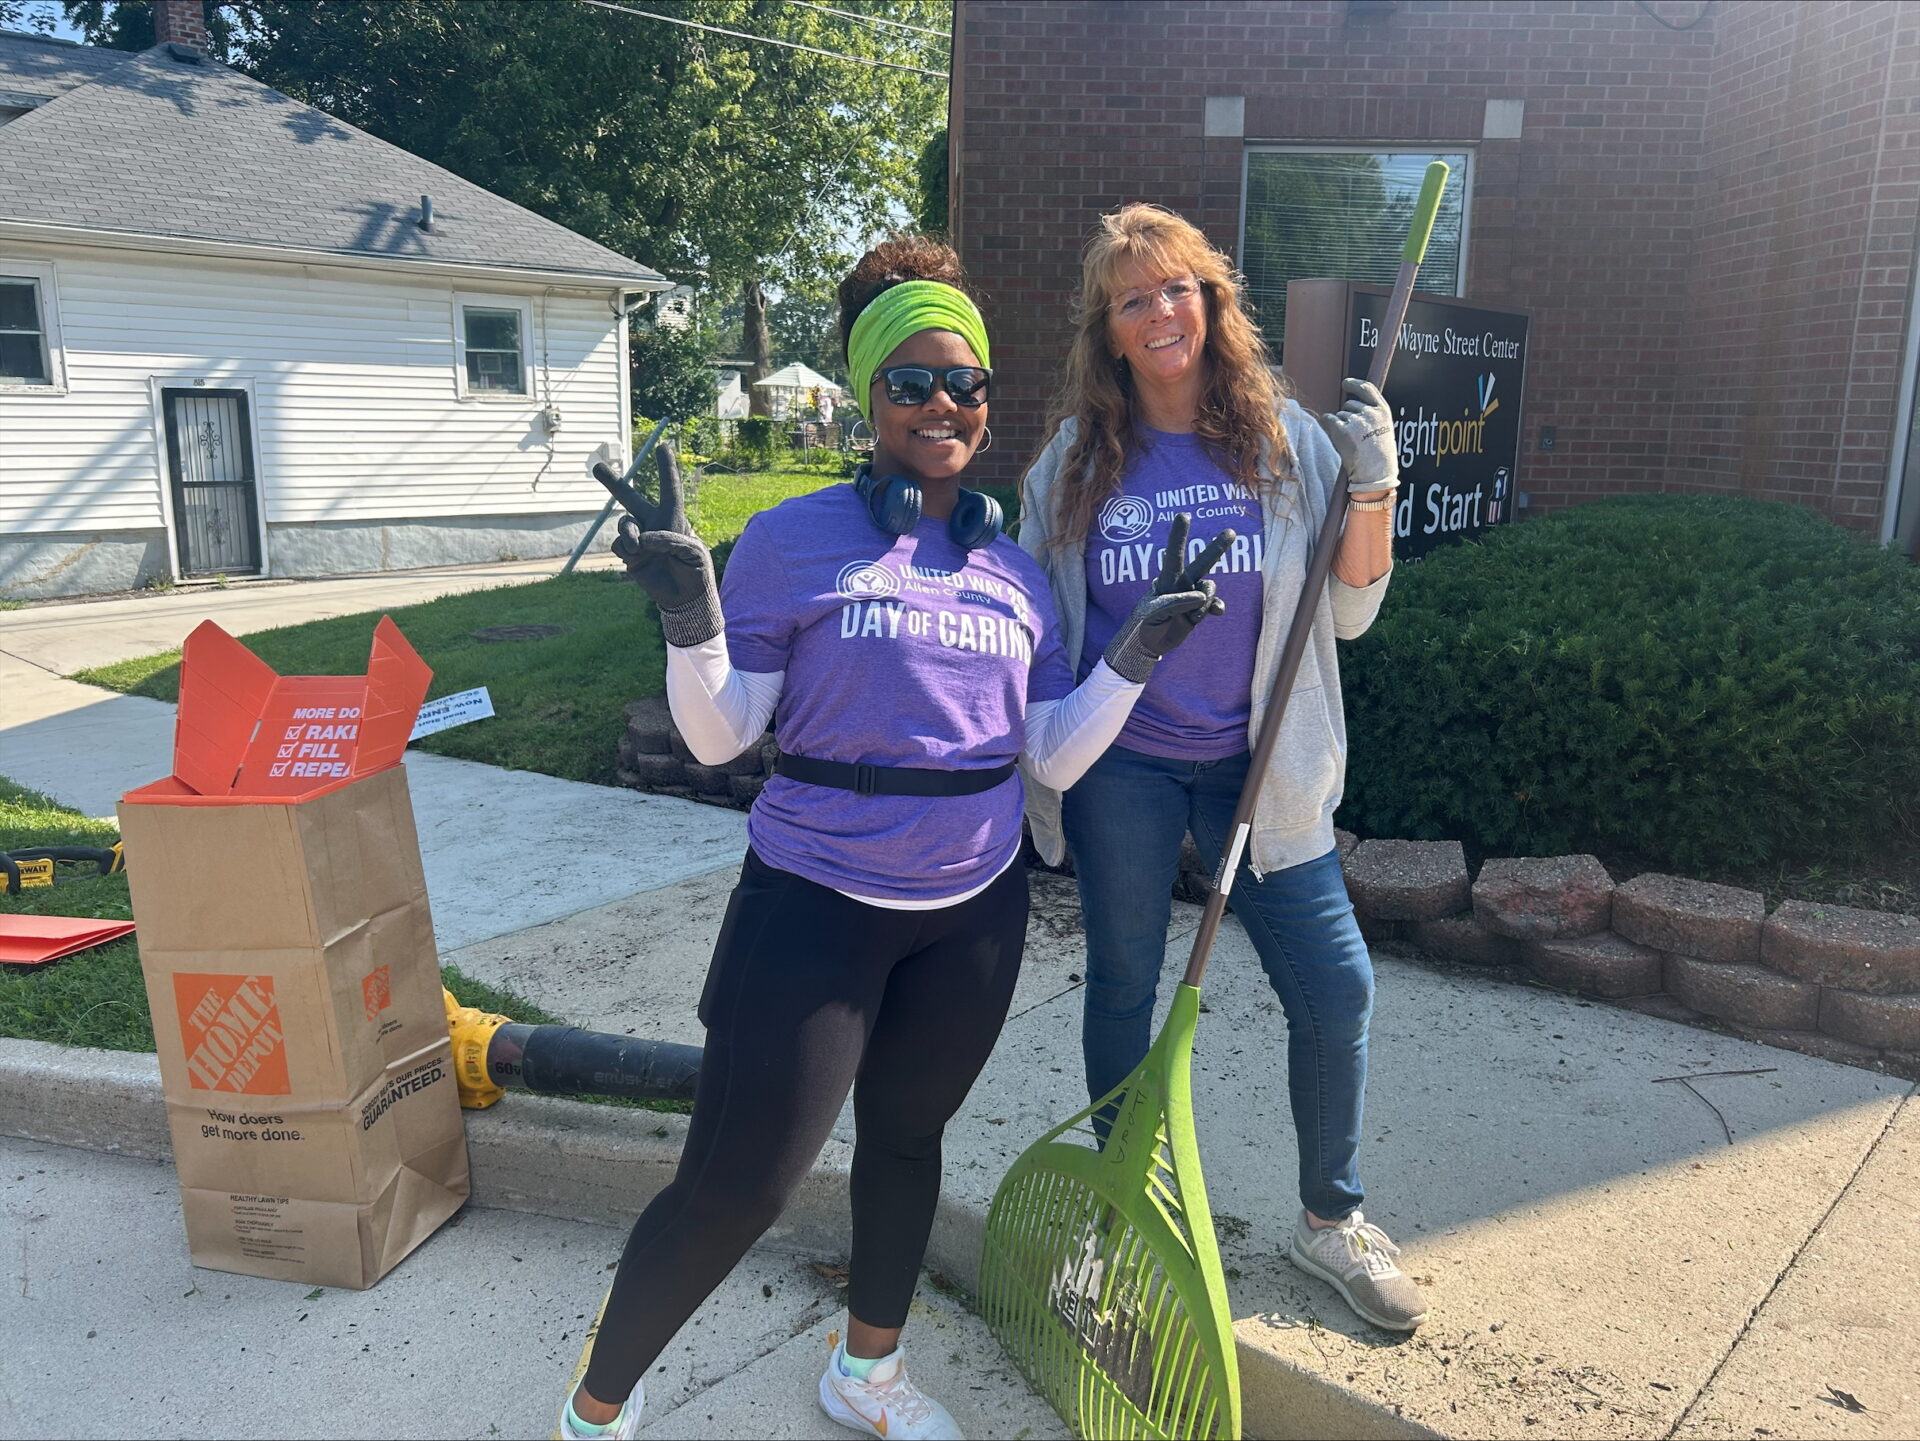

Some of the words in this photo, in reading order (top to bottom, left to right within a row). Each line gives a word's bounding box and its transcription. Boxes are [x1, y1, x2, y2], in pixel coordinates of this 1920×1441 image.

[1359, 318, 1379, 347] Ea
[1398, 323, 1440, 360] Wayne
[1444, 327, 1479, 356] Street
[1483, 332, 1519, 359] Center
[1155, 484, 1219, 509] UNITED
[1423, 483, 1482, 534] Start
[1196, 504, 1246, 519] County
[1100, 543, 1153, 585] DAY
[899, 563, 964, 589] UNITED
[966, 575, 1004, 598] WAY
[904, 580, 937, 596] Allen
[943, 588, 991, 604] County
[840, 601, 906, 639] DAY
[907, 609, 932, 636] OF
[293, 708, 336, 719] MORE
[297, 743, 340, 758] FILL
[188, 986, 224, 1032] THE
[187, 976, 276, 1091] HOME
[226, 1019, 284, 1092] DEPOT
[396, 1071, 413, 1084] OUR
[207, 1109, 235, 1124] How
[239, 1113, 284, 1125] doers
[201, 1124, 221, 1138] get
[223, 1128, 257, 1140] more
[230, 1194, 257, 1203] HEALTHY
